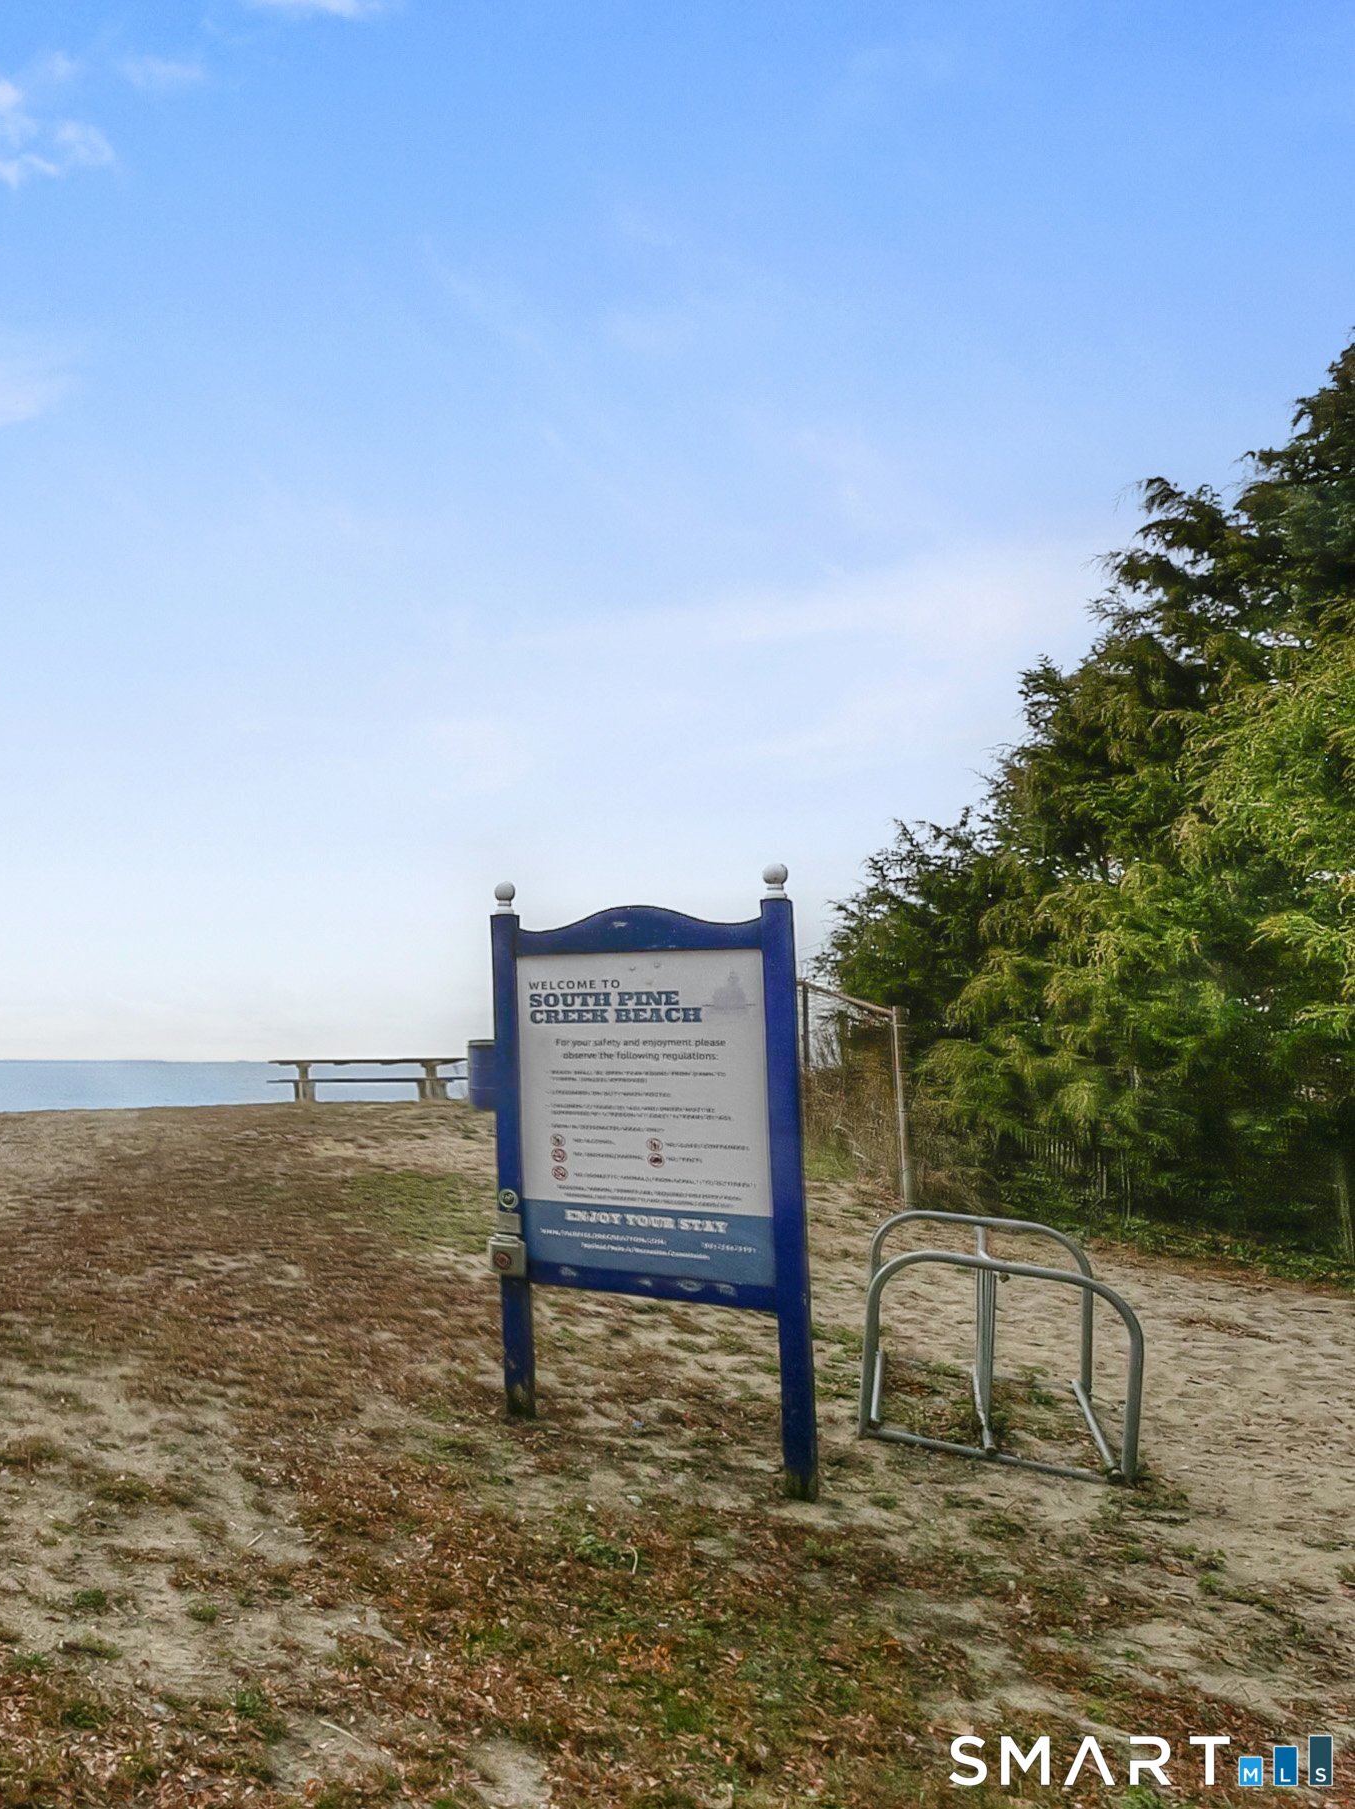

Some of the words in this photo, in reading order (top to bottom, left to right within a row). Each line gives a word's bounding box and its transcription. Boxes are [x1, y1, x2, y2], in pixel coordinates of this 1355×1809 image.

[529, 980, 596, 990] WELCOME
[601, 979, 620, 989] TO
[529, 992, 612, 1008] SOUTH
[618, 991, 679, 1006] PINE
[530, 1009, 609, 1024] CREEK
[615, 1008, 702, 1023] BEACH
[555, 1038, 570, 1047] For
[572, 1040, 592, 1049] your
[594, 1038, 621, 1048] safety
[623, 1038, 640, 1047] and
[642, 1039, 692, 1049] enjoyment
[695, 1038, 726, 1048] please
[563, 1051, 596, 1060] observe
[599, 1051, 614, 1060] the
[616, 1051, 660, 1062] following
[564, 1209, 622, 1226] ENJOY
[624, 1213, 677, 1229] YOUR
[678, 1217, 728, 1234] STAY
